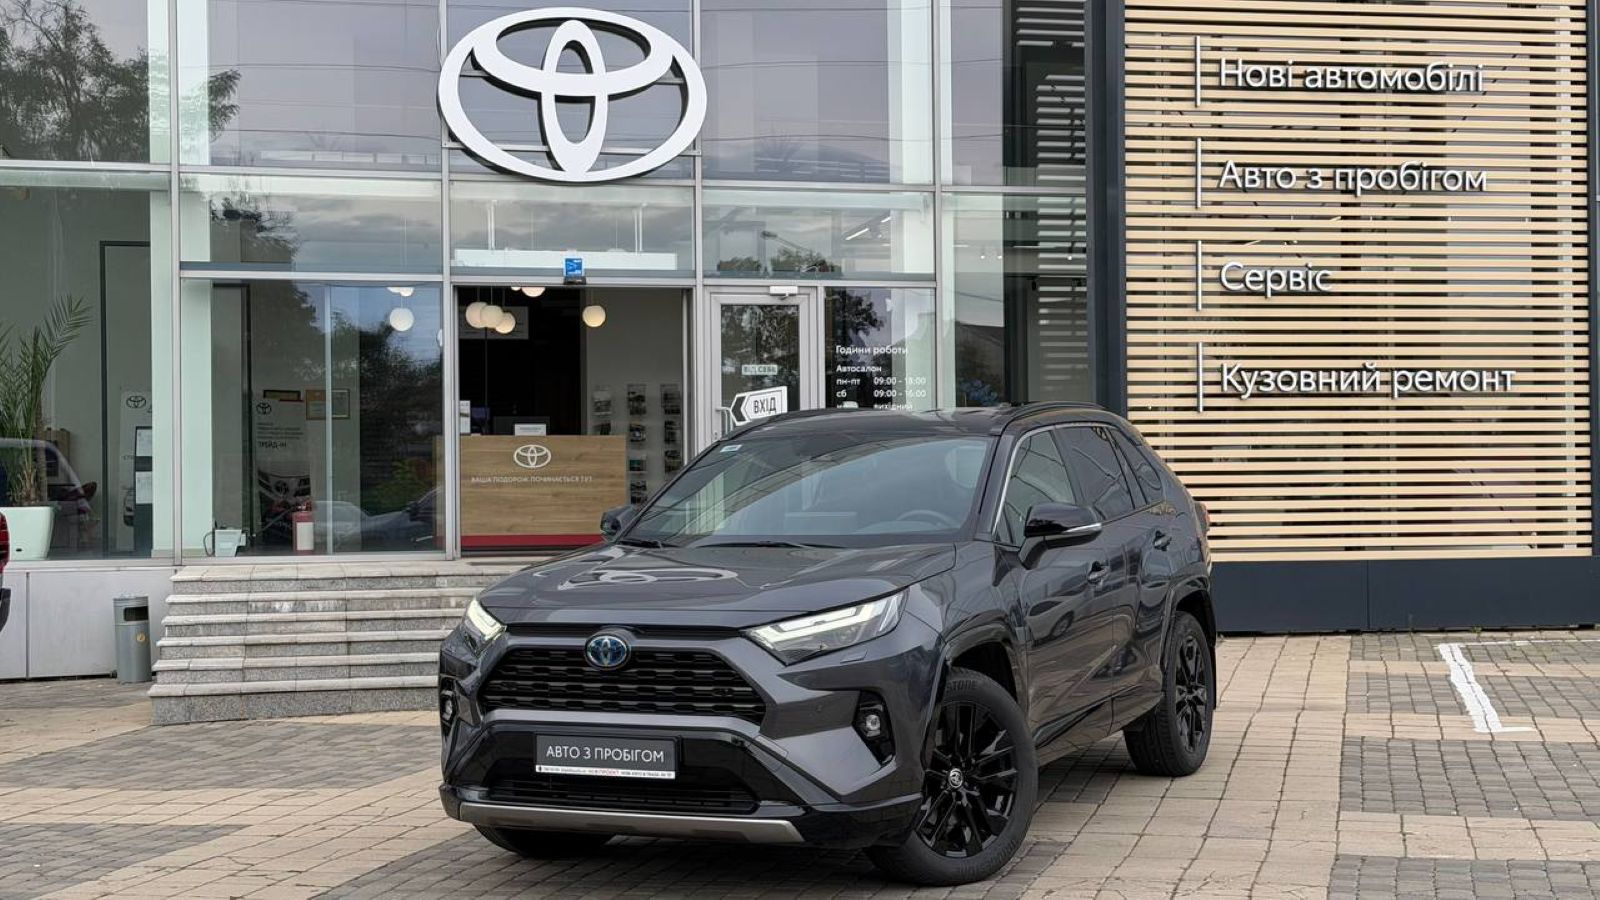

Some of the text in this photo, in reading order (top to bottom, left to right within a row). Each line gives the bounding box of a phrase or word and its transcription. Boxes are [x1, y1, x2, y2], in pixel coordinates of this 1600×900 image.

[1219, 58, 1484, 93] Нові автомобілі
[1219, 160, 1488, 197] Авто з пробігом
[1219, 261, 1333, 298] Сервіс
[836, 345, 908, 356] Години роботи
[836, 364, 882, 373] Автосалон
[836, 377, 861, 386] пн-пт
[873, 377, 897, 386] 09:00
[1220, 361, 1517, 401] Кузовний ремонт
[836, 389, 847, 398] сб
[873, 389, 897, 398] 09:00
[753, 396, 777, 415] ВХІД
[545, 745, 665, 763] АВТО З ПРОБІГОМ
